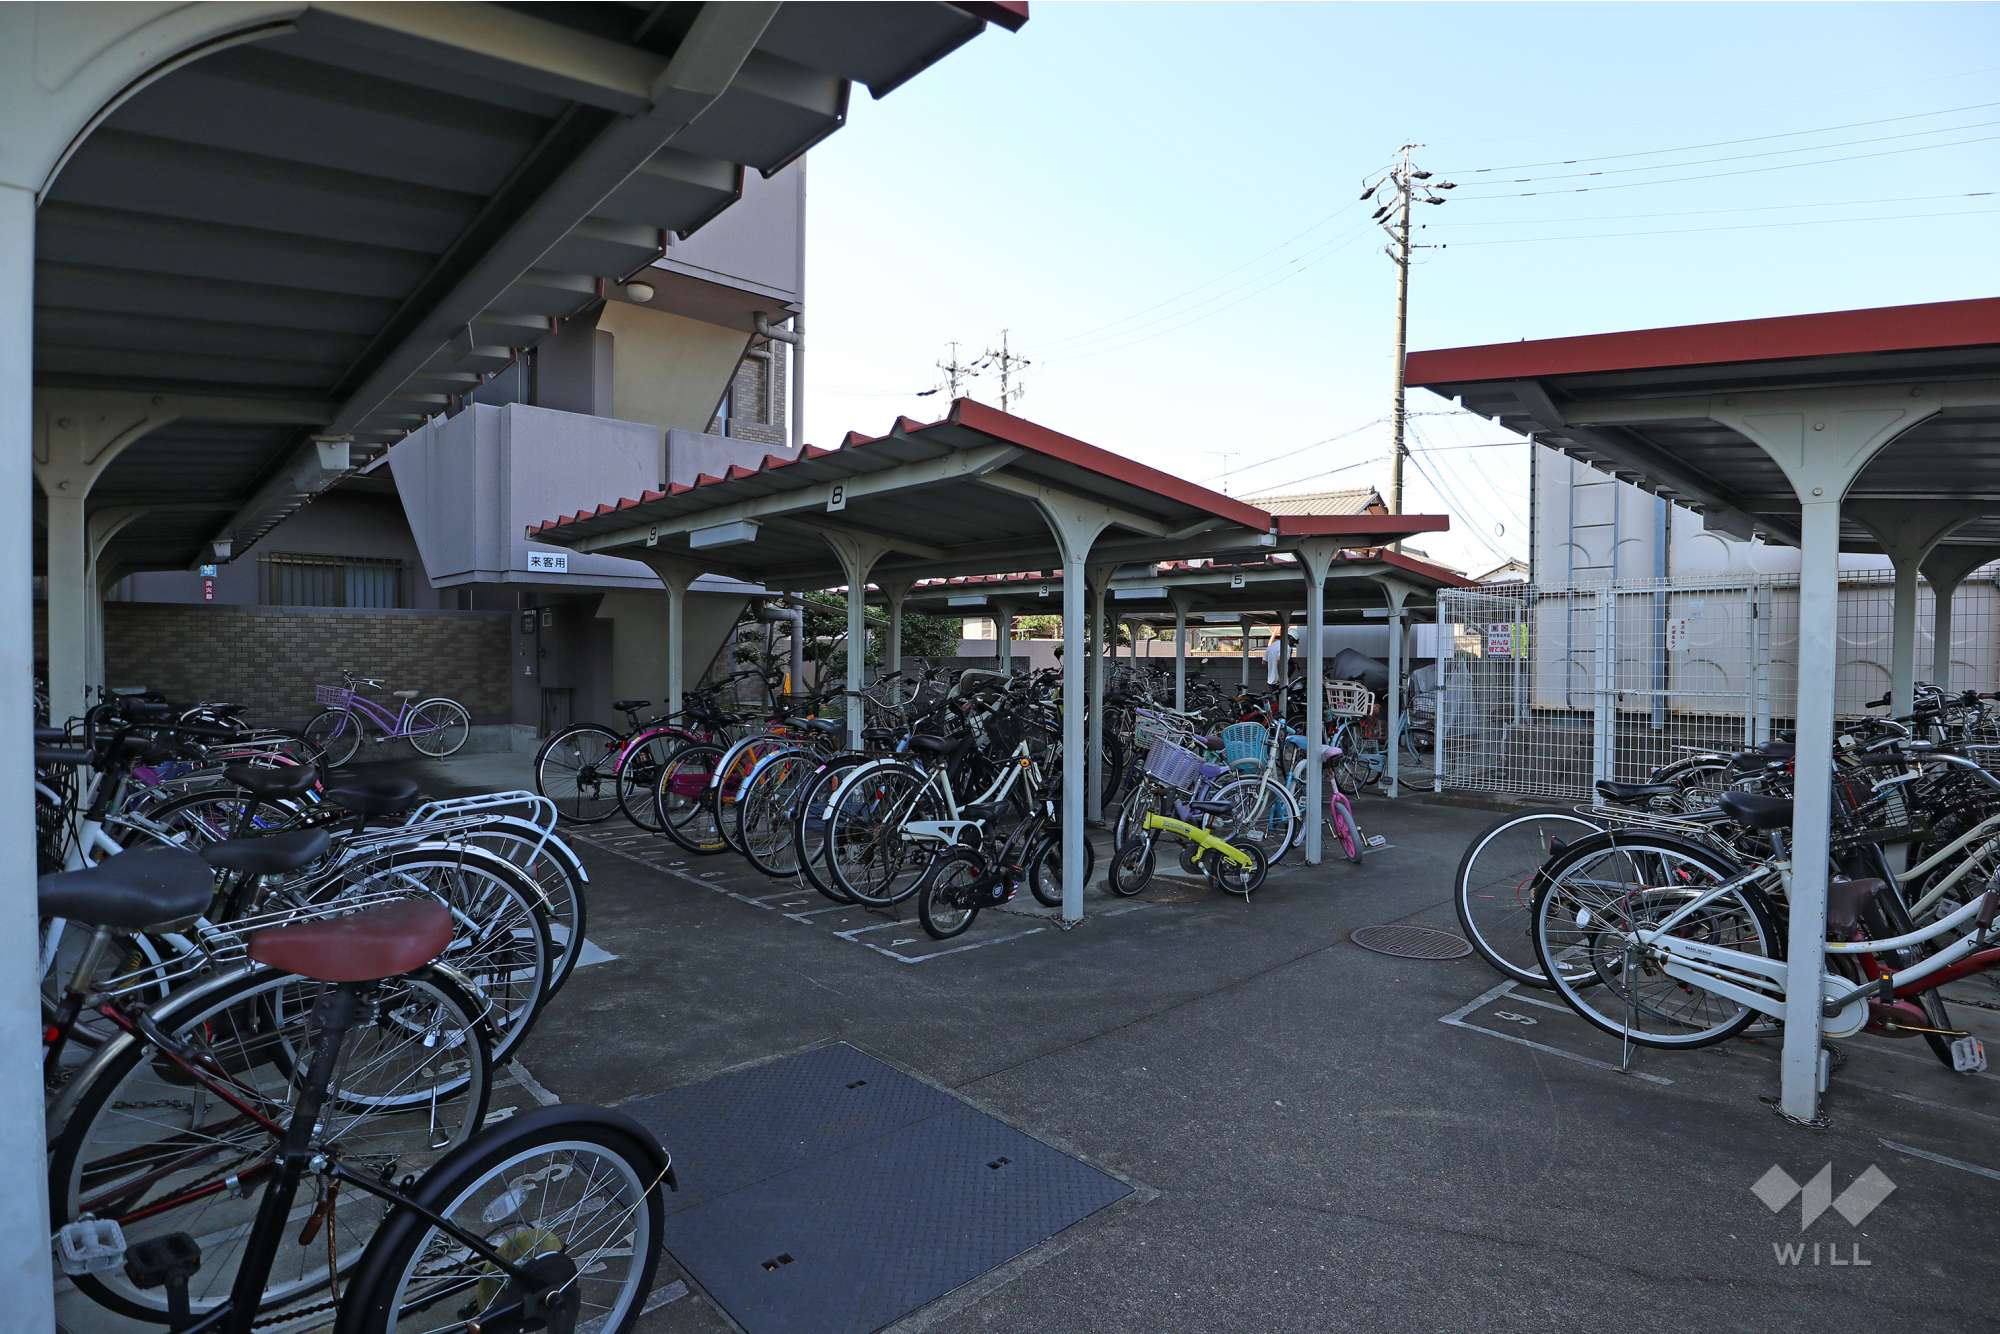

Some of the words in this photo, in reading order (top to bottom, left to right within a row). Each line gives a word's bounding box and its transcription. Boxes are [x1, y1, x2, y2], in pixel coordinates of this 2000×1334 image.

[832, 486, 844, 505] 8
[649, 526, 657, 541] 9
[530, 556, 566, 568] 来客用
[1041, 585, 1049, 594] 3
